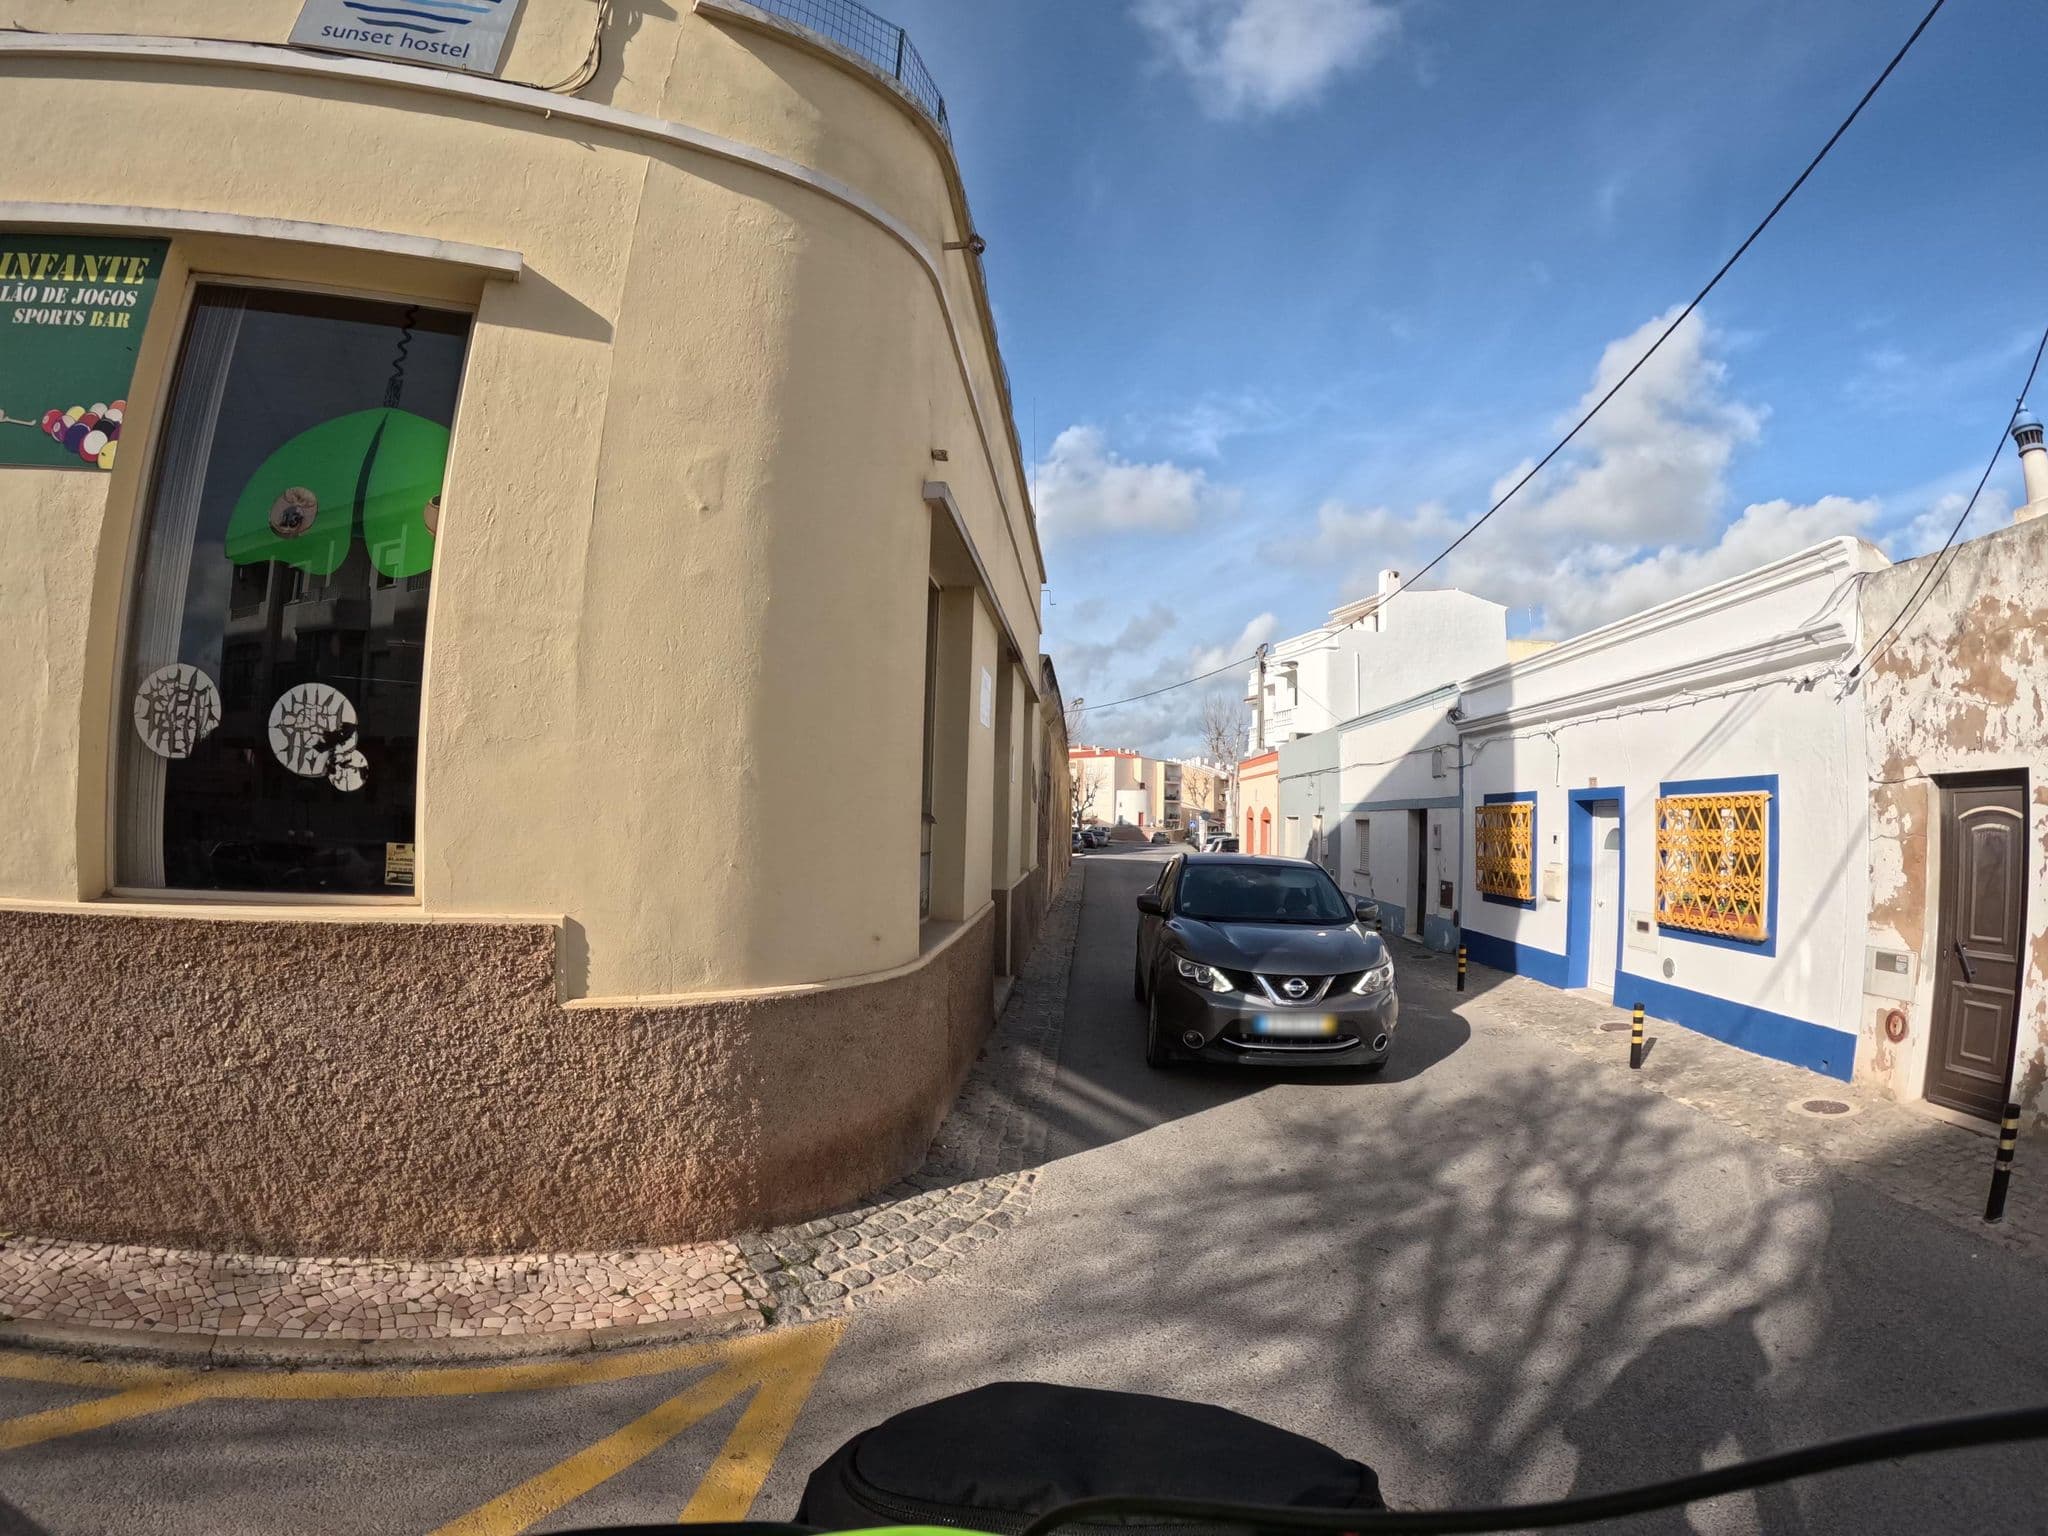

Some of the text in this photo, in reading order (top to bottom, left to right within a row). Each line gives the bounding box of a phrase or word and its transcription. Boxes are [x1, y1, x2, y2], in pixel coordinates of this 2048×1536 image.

[321, 25, 470, 58] sunset hostel
[0, 252, 150, 285] INFANTE
[41, 286, 69, 304] DE
[71, 288, 138, 307] JOGOS
[12, 308, 131, 329] SPORTS BAR
